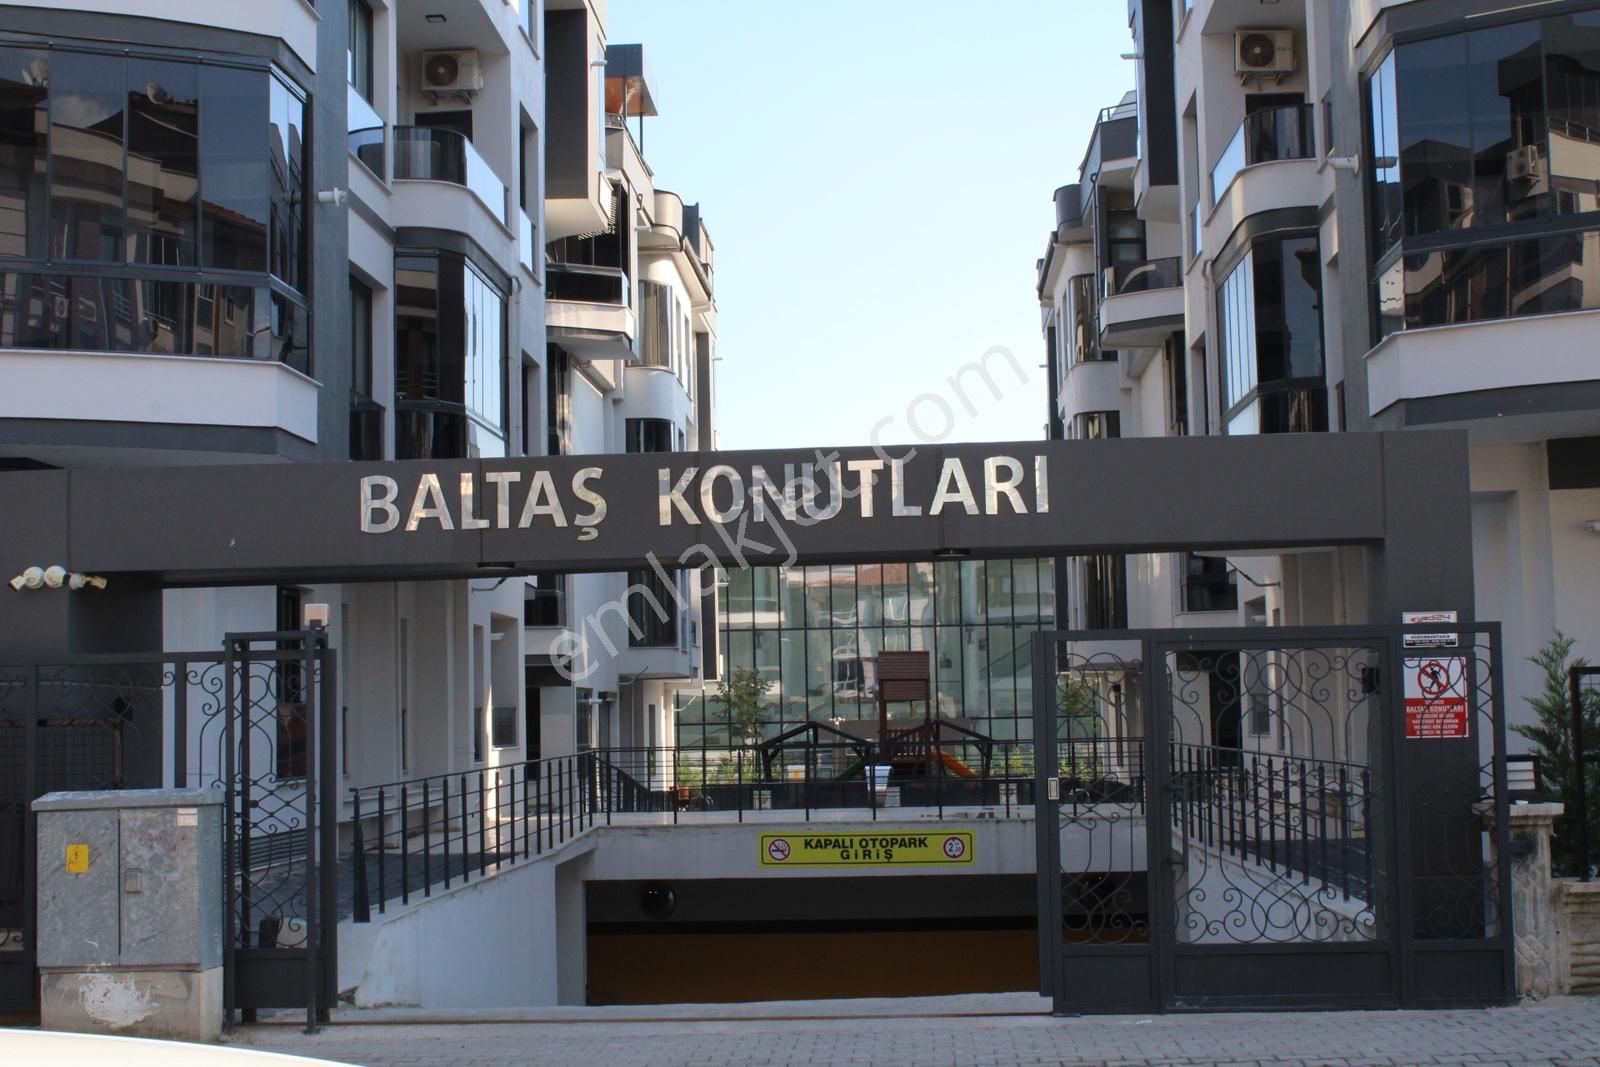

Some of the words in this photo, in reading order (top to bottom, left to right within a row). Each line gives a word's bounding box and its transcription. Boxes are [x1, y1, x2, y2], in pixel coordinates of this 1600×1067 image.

[360, 467, 607, 541] BALTAŞ
[658, 455, 1049, 526] KONUTLARI
[804, 838, 853, 849] KAPALI
[859, 837, 928, 849] OTOPARK
